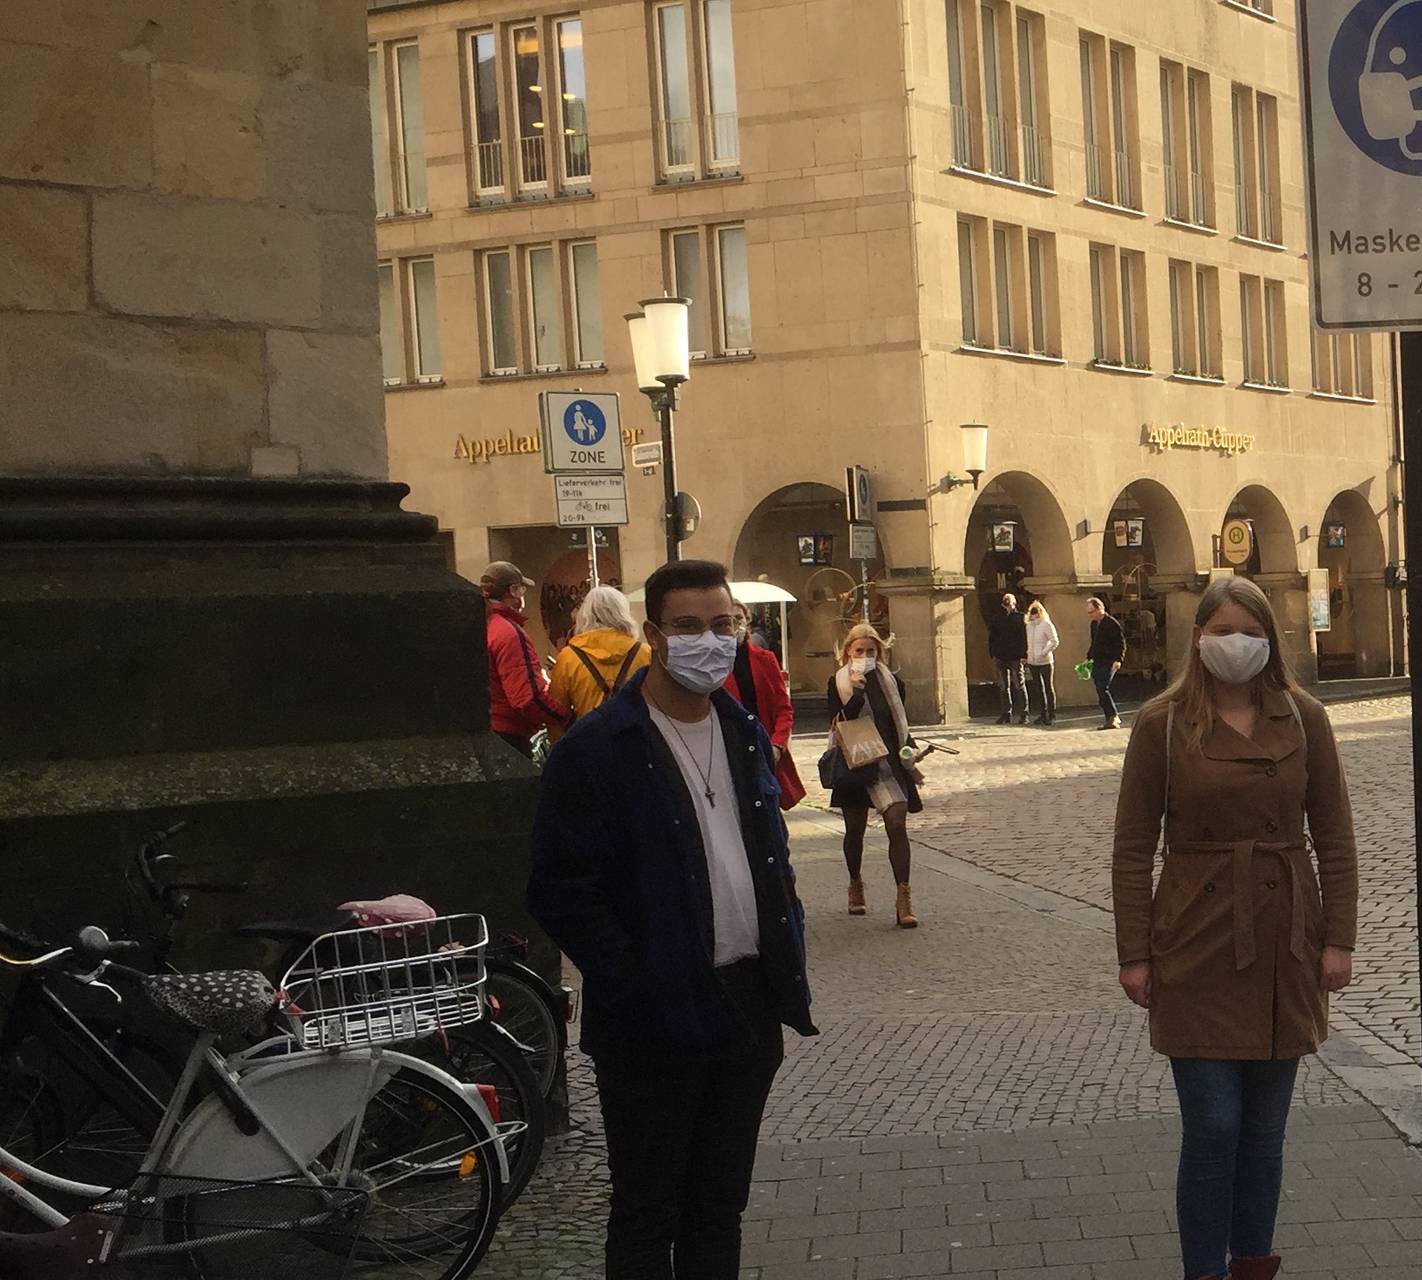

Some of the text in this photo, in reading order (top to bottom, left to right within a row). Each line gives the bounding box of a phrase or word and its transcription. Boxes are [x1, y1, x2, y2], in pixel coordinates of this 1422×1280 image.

[1357, 272, 1373, 297] 8
[570, 450, 606, 463] ZONE
[594, 502, 610, 511] frei
